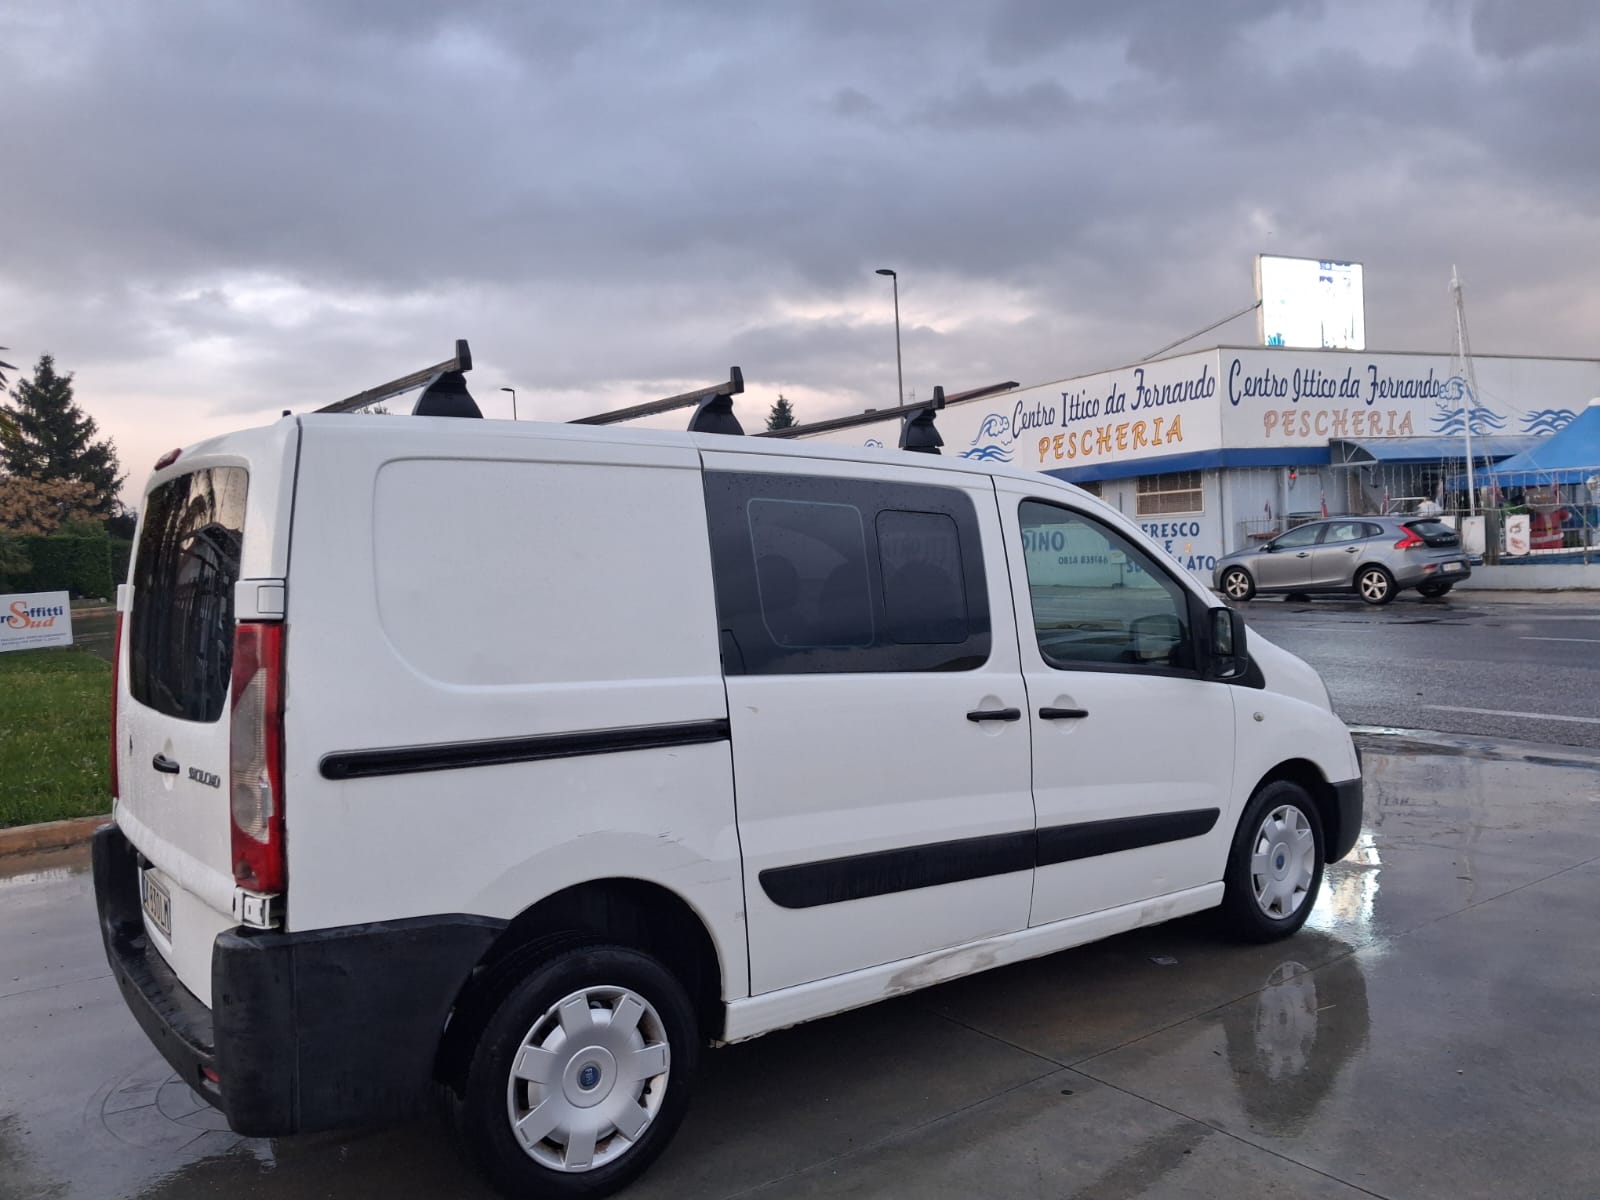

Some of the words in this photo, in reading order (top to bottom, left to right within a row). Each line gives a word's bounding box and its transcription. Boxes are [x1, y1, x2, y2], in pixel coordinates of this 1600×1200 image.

[1228, 358, 1288, 406] Centro
[1292, 368, 1336, 403] Ittico
[1340, 366, 1360, 399] da
[1365, 364, 1440, 405] Fernando
[1012, 400, 1055, 439] Centro
[1061, 390, 1100, 427] Ittico
[1104, 383, 1126, 416] da
[1130, 365, 1216, 411] Fernando
[1038, 414, 1184, 463] PESCHERIA
[1263, 408, 1414, 438] PESCHERIA
[1141, 522, 1200, 538] FRESCO
[1164, 540, 1173, 554] E
